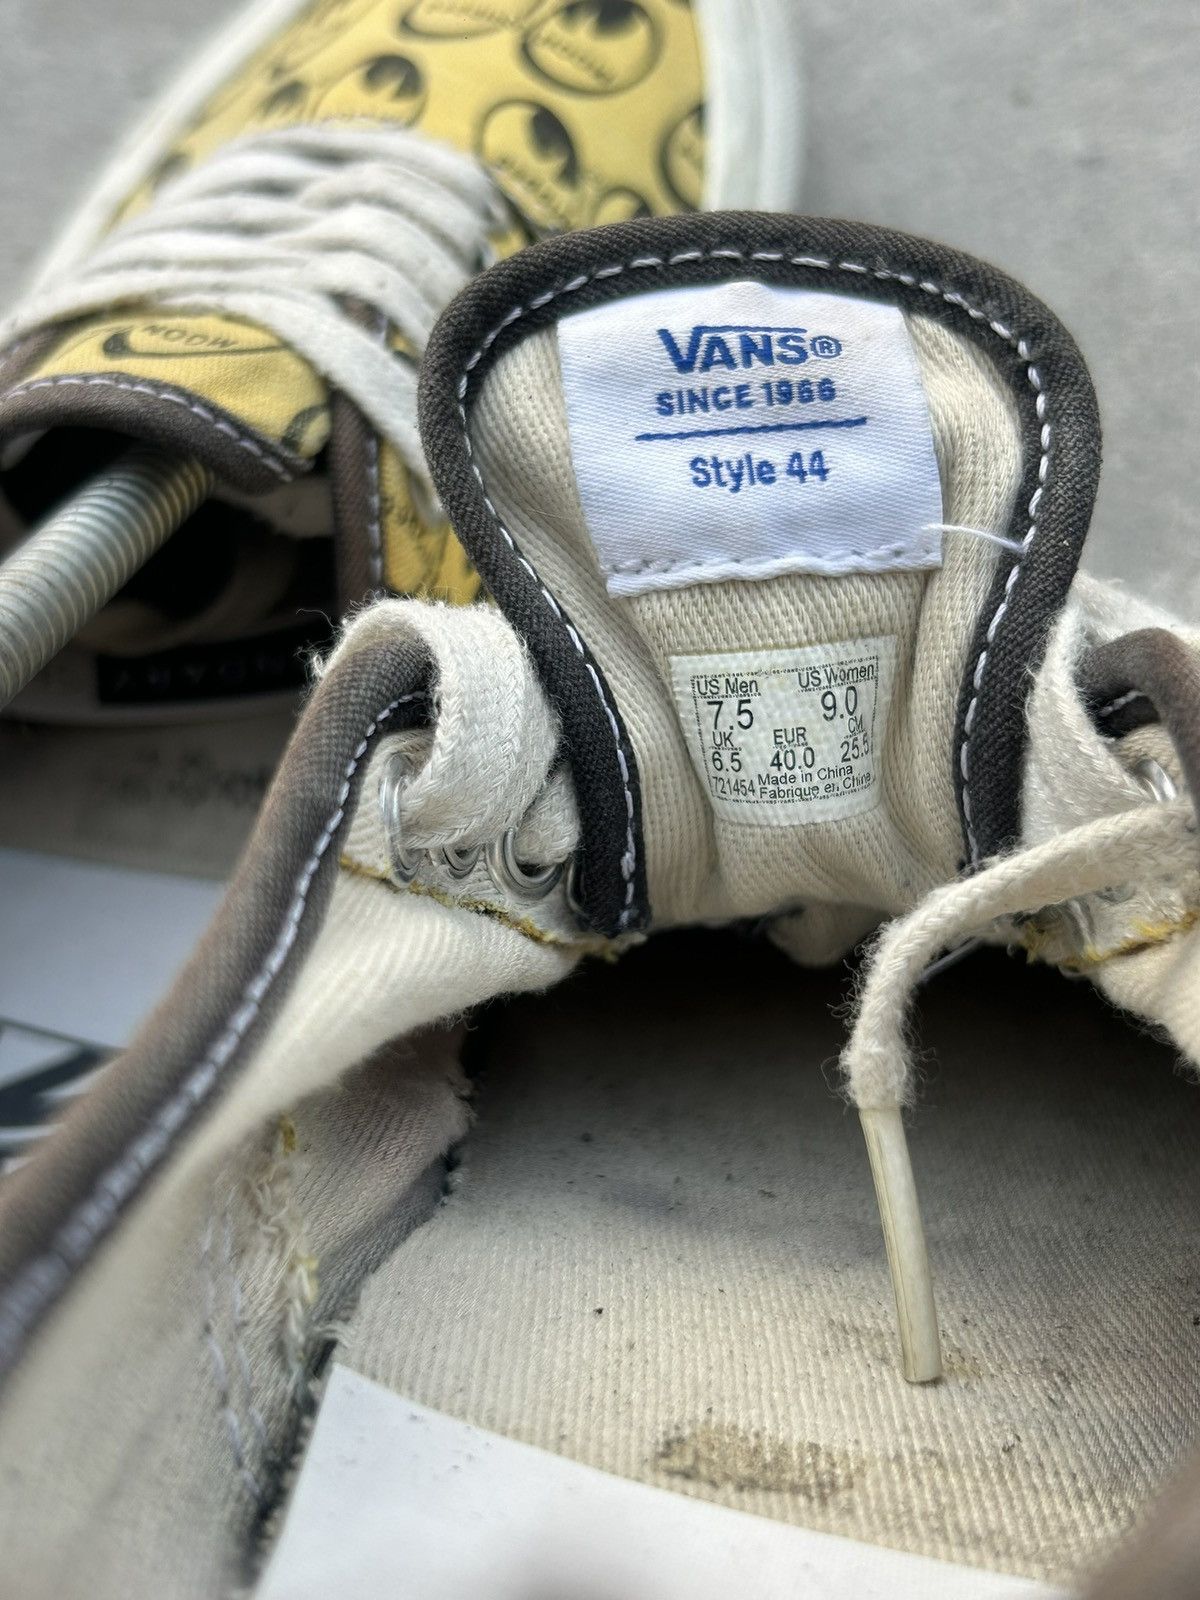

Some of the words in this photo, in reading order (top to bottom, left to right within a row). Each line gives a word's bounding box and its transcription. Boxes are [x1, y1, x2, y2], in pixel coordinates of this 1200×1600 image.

[655, 384, 753, 417] SINCE
[761, 378, 837, 407] 1966
[689, 453, 777, 493] Style
[785, 450, 830, 484] 44
[696, 678, 720, 696] US
[725, 677, 759, 694] Men
[797, 670, 822, 689] US
[823, 664, 875, 685] Women
[706, 699, 754, 730] 7.5
[820, 685, 858, 722] 9.0
[773, 727, 807, 745] EUR
[847, 715, 864, 734] CM
[712, 731, 734, 748] UK
[840, 733, 870, 763] 25.5
[712, 751, 742, 772] 6.5
[770, 746, 815, 771] 40.0
[712, 776, 756, 797] 721454
[757, 772, 797, 787] Made
[800, 771, 813, 783] in
[816, 765, 853, 780] China
[759, 784, 820, 800] Fabrique
[842, 771, 872, 790] China
